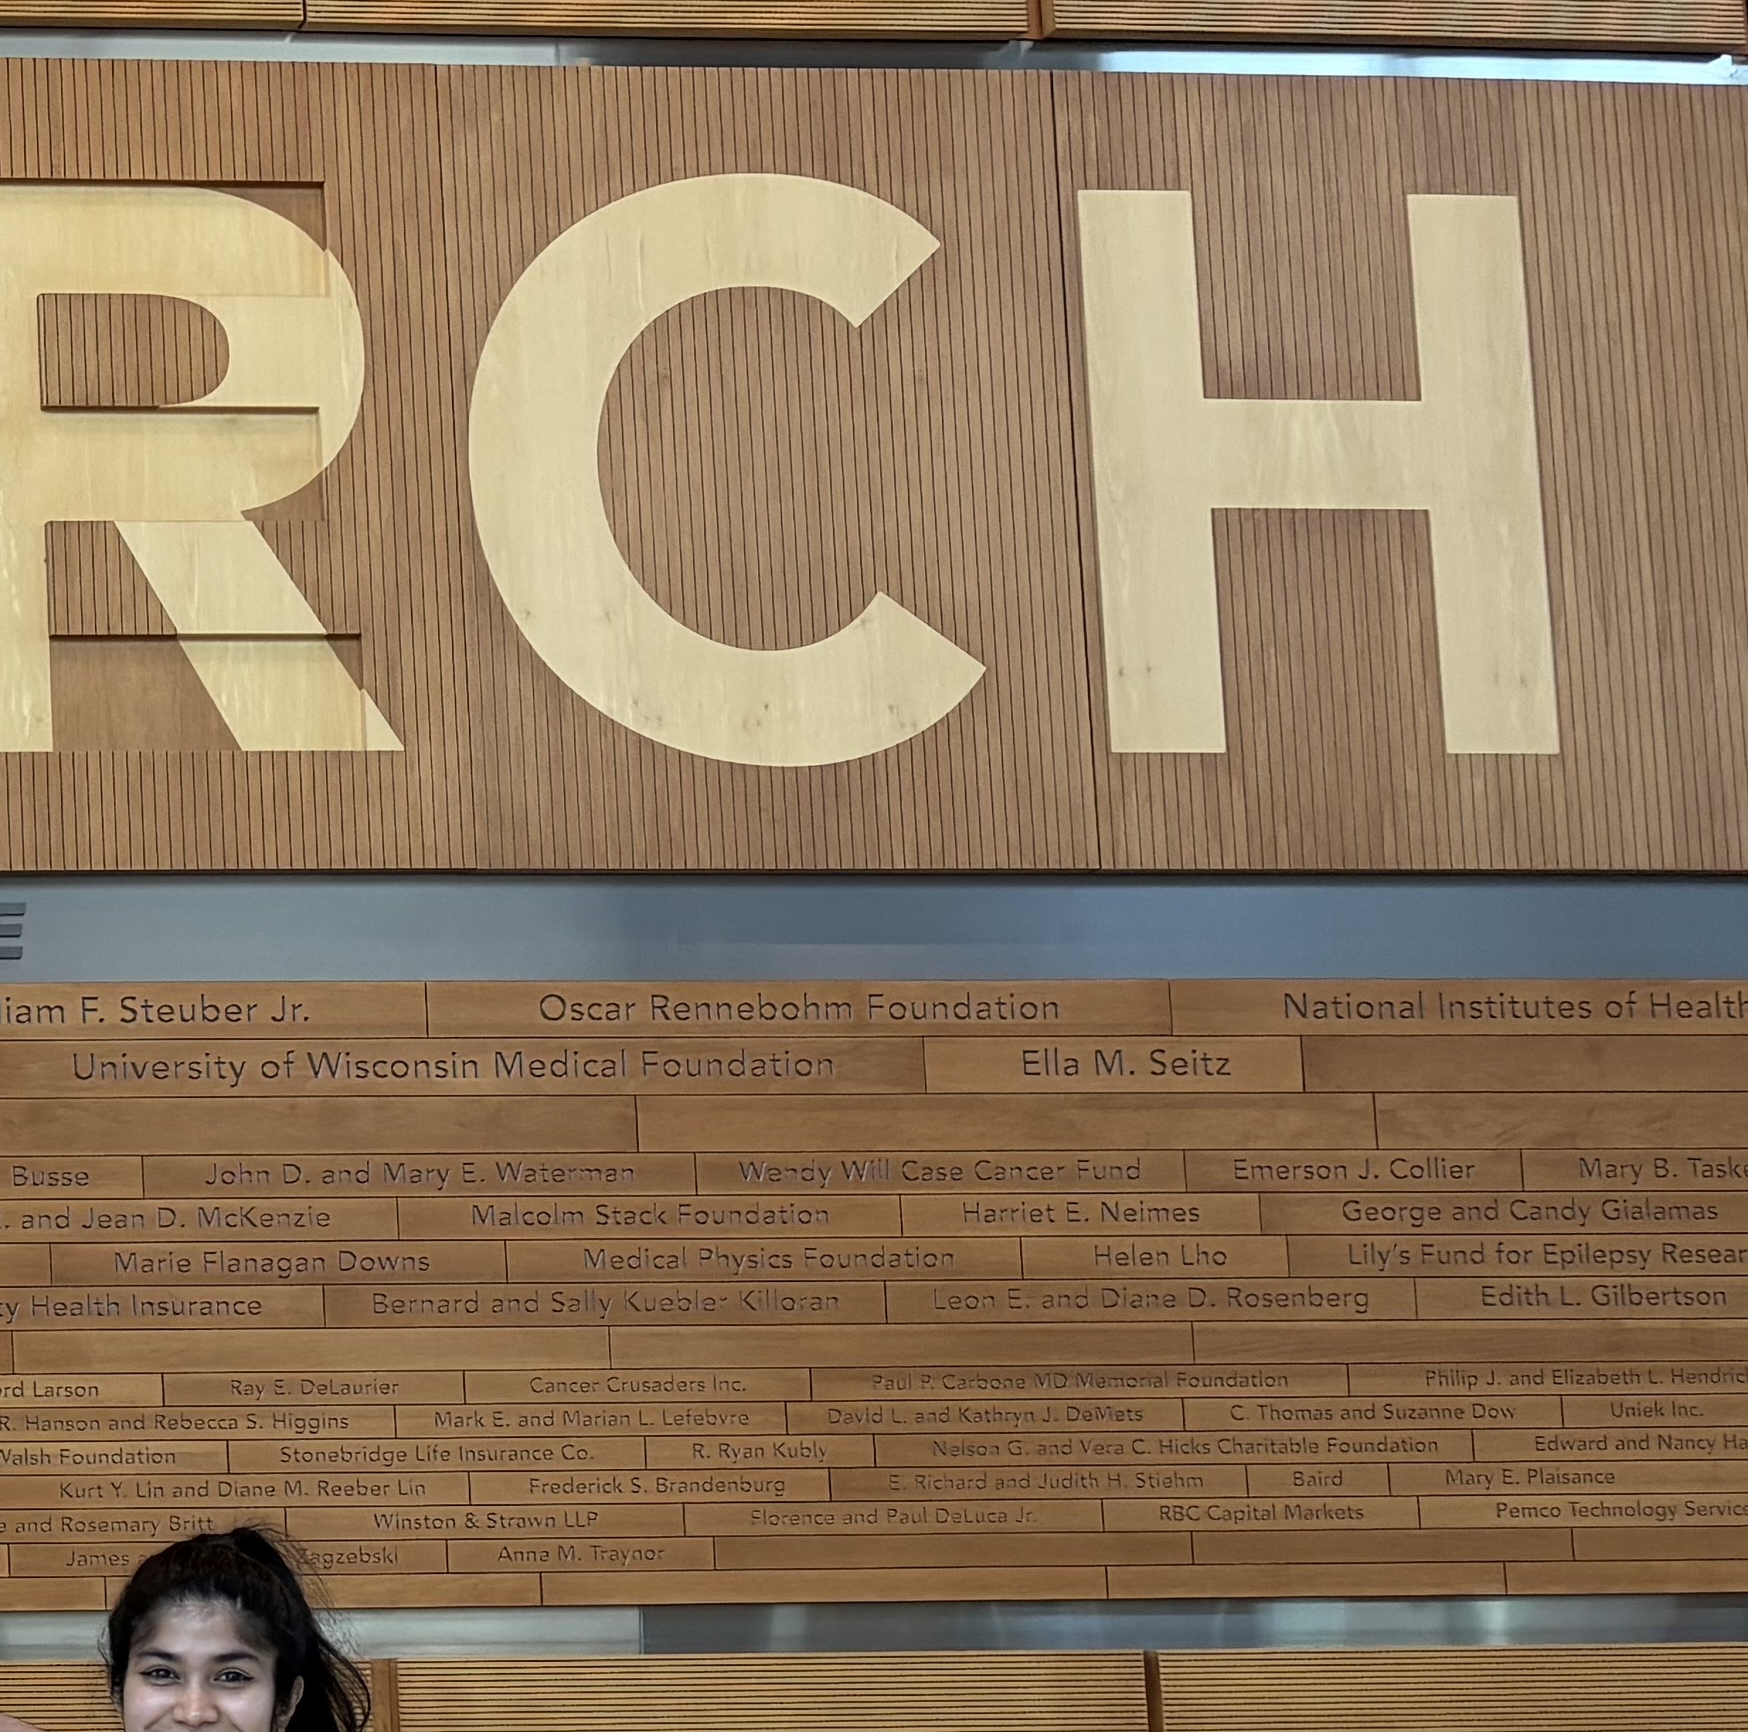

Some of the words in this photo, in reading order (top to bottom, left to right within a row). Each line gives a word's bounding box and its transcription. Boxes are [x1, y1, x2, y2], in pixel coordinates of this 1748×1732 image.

[81, 996, 105, 1025] F.
[119, 993, 258, 1024] Steuber
[270, 994, 310, 1023] Jr.
[539, 993, 636, 1022] Oscar
[650, 992, 852, 1021] Rennebohm
[868, 991, 1059, 1021] Foundation
[1284, 990, 1424, 1020] National
[1438, 991, 1593, 1020] Institutes
[1604, 990, 1637, 1019] of
[72, 1052, 247, 1089] University
[260, 1049, 296, 1079] of
[306, 1051, 479, 1079] Wisconsin
[494, 1048, 626, 1079] Medical
[641, 1048, 833, 1078] Foundation
[1022, 1046, 1079, 1077] Ella
[1094, 1049, 1136, 1077] M.
[1149, 1048, 1232, 1077] Seitz
[1233, 1158, 1348, 1181] Emerson
[1358, 1157, 1379, 1180] J.
[1389, 1156, 1476, 1180] Collier
[962, 1201, 1056, 1224] Harriet
[1066, 1201, 1090, 1223] E.
[1100, 1200, 1200, 1223] Neimes
[1342, 1199, 1442, 1228] George
[1452, 1198, 1499, 1221] and
[1509, 1197, 1591, 1227] Candy
[1601, 1197, 1719, 1221] Gialamas
[1094, 1242, 1169, 1267] Helen
[1180, 1242, 1228, 1267] Lho
[31, 1292, 120, 1317] Health
[132, 1293, 263, 1317] Insurance
[1481, 1283, 1551, 1307] Edith
[1559, 1285, 1582, 1307] L.
[1591, 1282, 1727, 1307] Gilbertson
[1671, 1400, 1704, 1417] Inc.
[692, 1442, 711, 1459] R.
[718, 1442, 765, 1465] Ryan
[772, 1441, 826, 1463] Kubly
[1293, 1469, 1343, 1487] Baird
[1445, 1468, 1494, 1491] Mary
[1501, 1468, 1520, 1485] E.
[1527, 1467, 1616, 1485] Plaisance
[373, 1512, 456, 1531] Winston
[464, 1511, 481, 1530] &
[486, 1511, 556, 1529] Strawn
[564, 1511, 599, 1528] LLP
[1159, 1504, 1201, 1522] RBC
[1206, 1503, 1277, 1525] Capital
[1284, 1502, 1365, 1521] Markets
